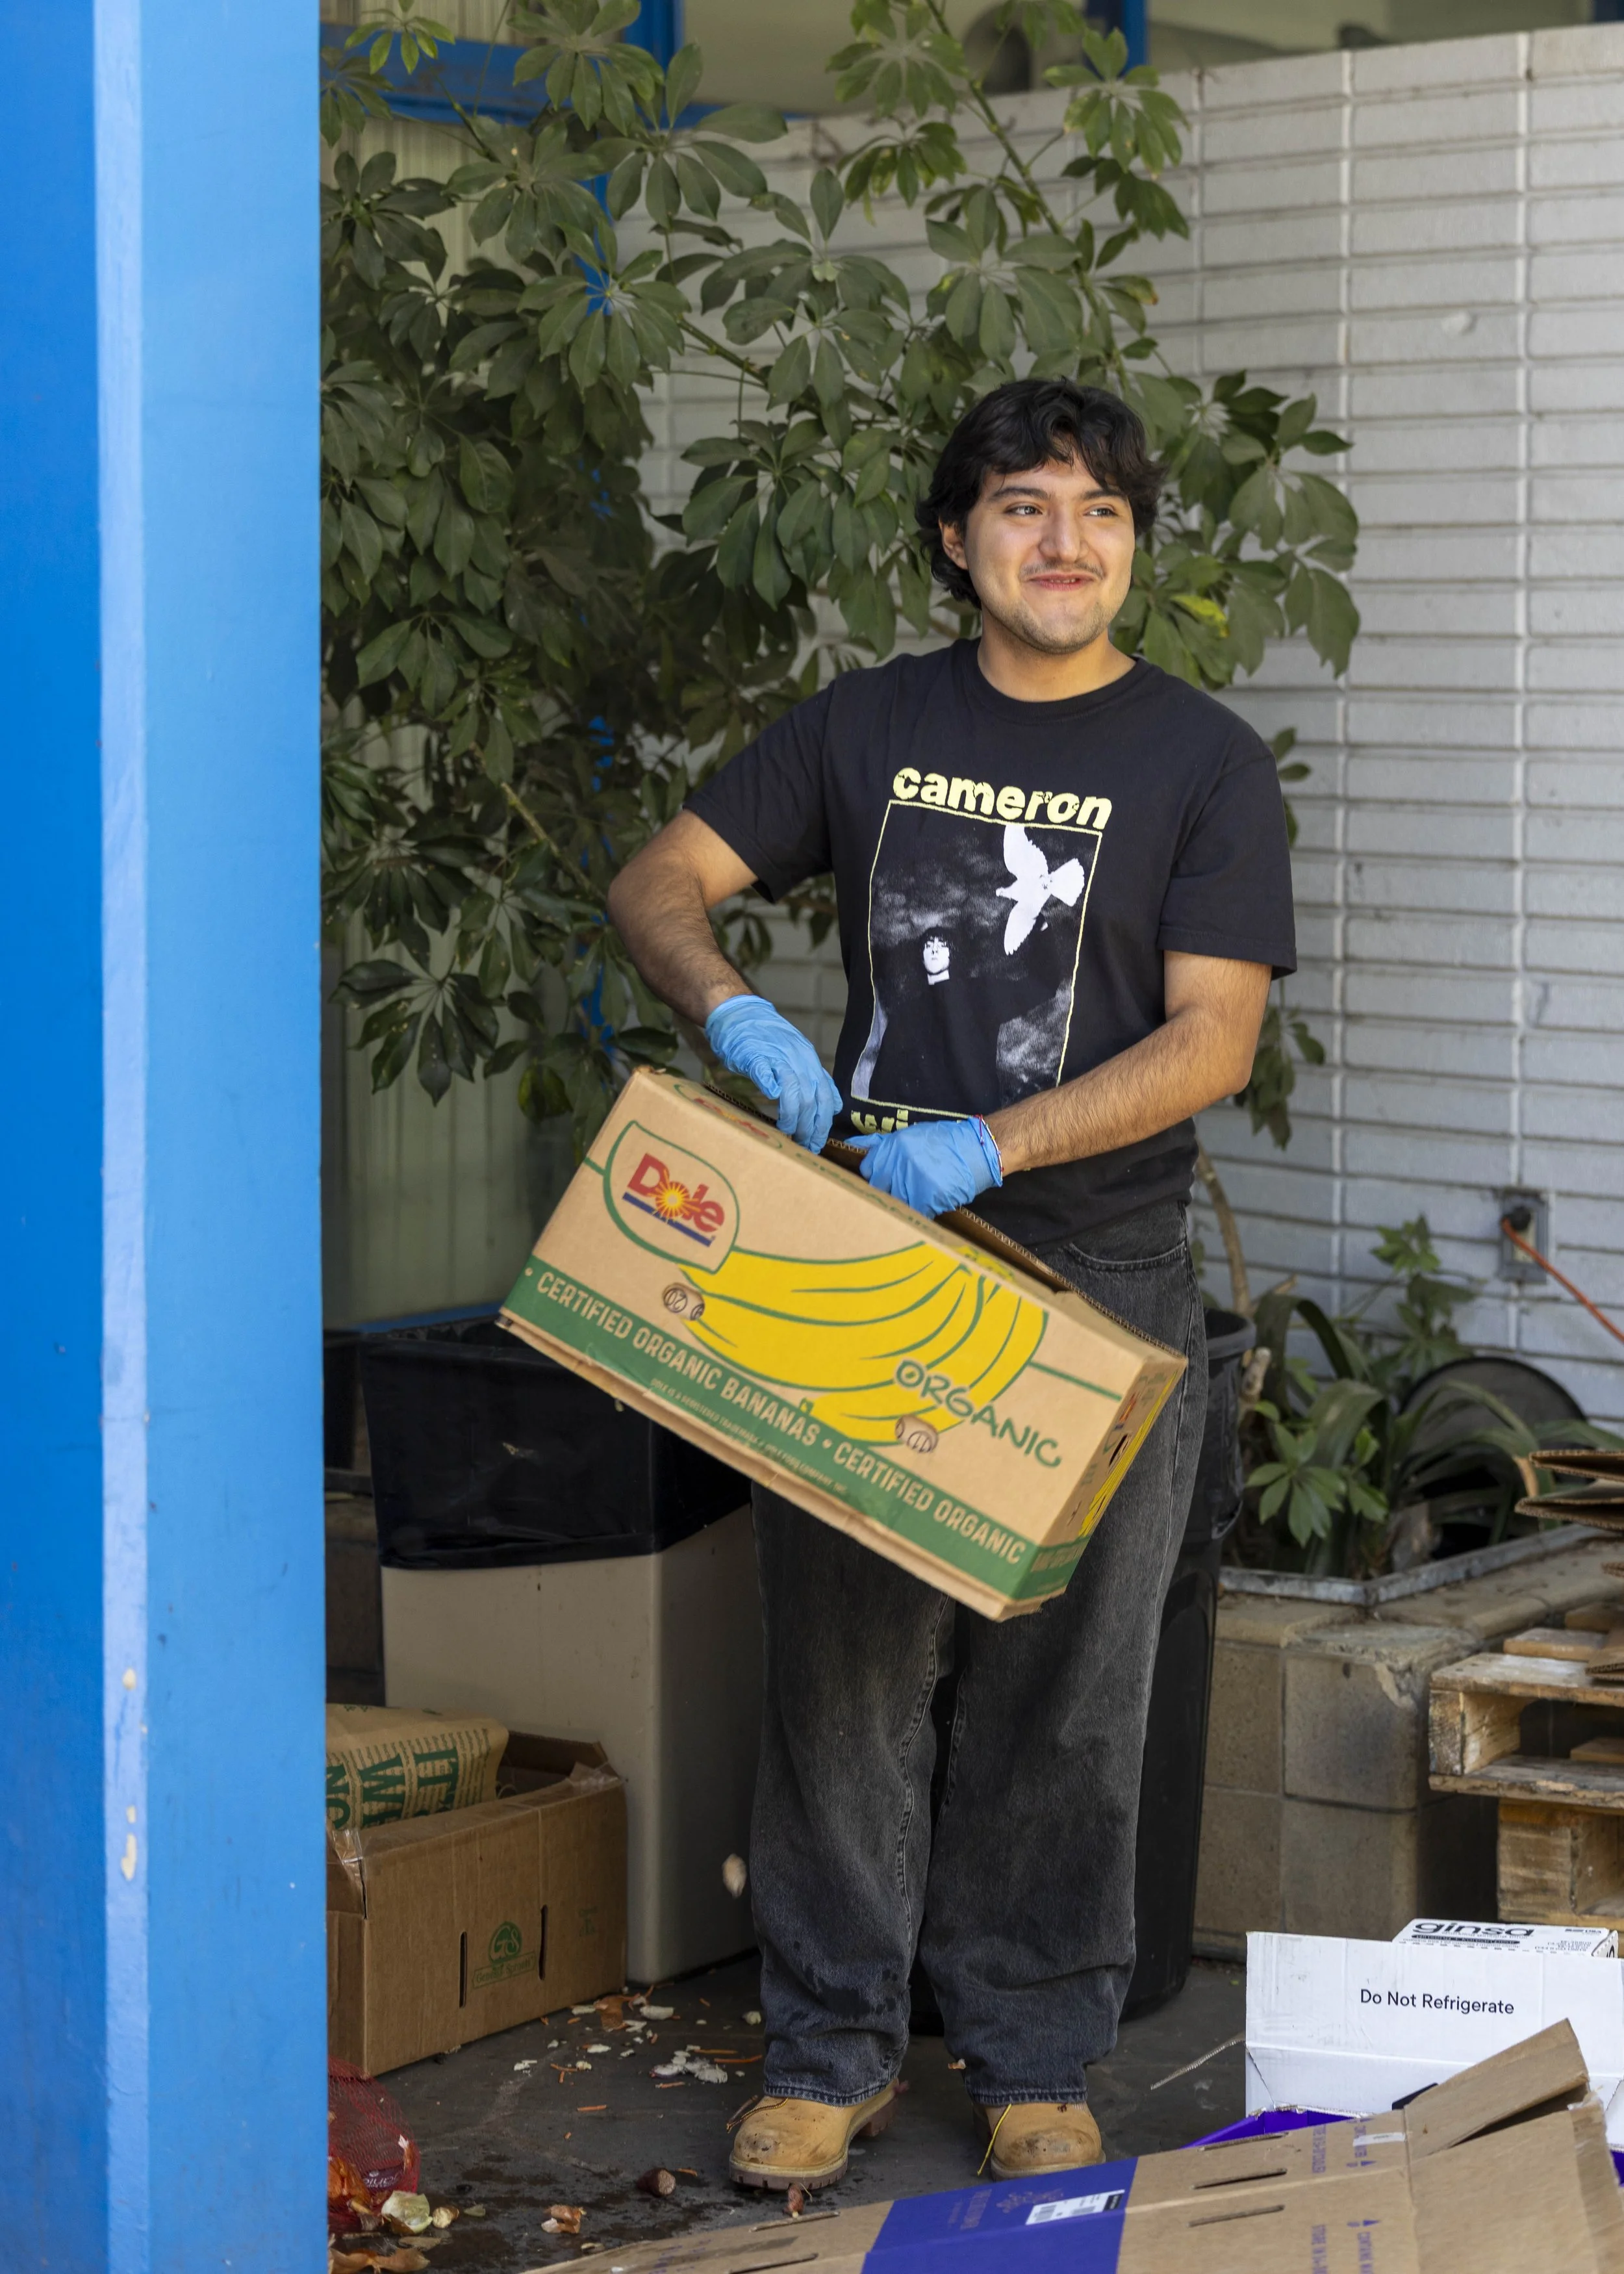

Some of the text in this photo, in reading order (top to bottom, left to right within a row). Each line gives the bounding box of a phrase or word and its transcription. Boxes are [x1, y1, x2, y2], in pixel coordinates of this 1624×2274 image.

[893, 767, 1113, 830] cameron
[627, 1153, 726, 1234] Dole
[537, 1271, 633, 1339] CERTIFIED
[633, 1327, 722, 1391] ORGANIC
[722, 1379, 820, 1446] BANANAS
[833, 1441, 932, 1513] CERTIFIED
[935, 1502, 1026, 1564] ORGANIC
[894, 1359, 1061, 1468] ORGANIC
[1413, 1921, 1535, 1936] ginsa
[1360, 1988, 1515, 2015] Do Not Refrigerate
